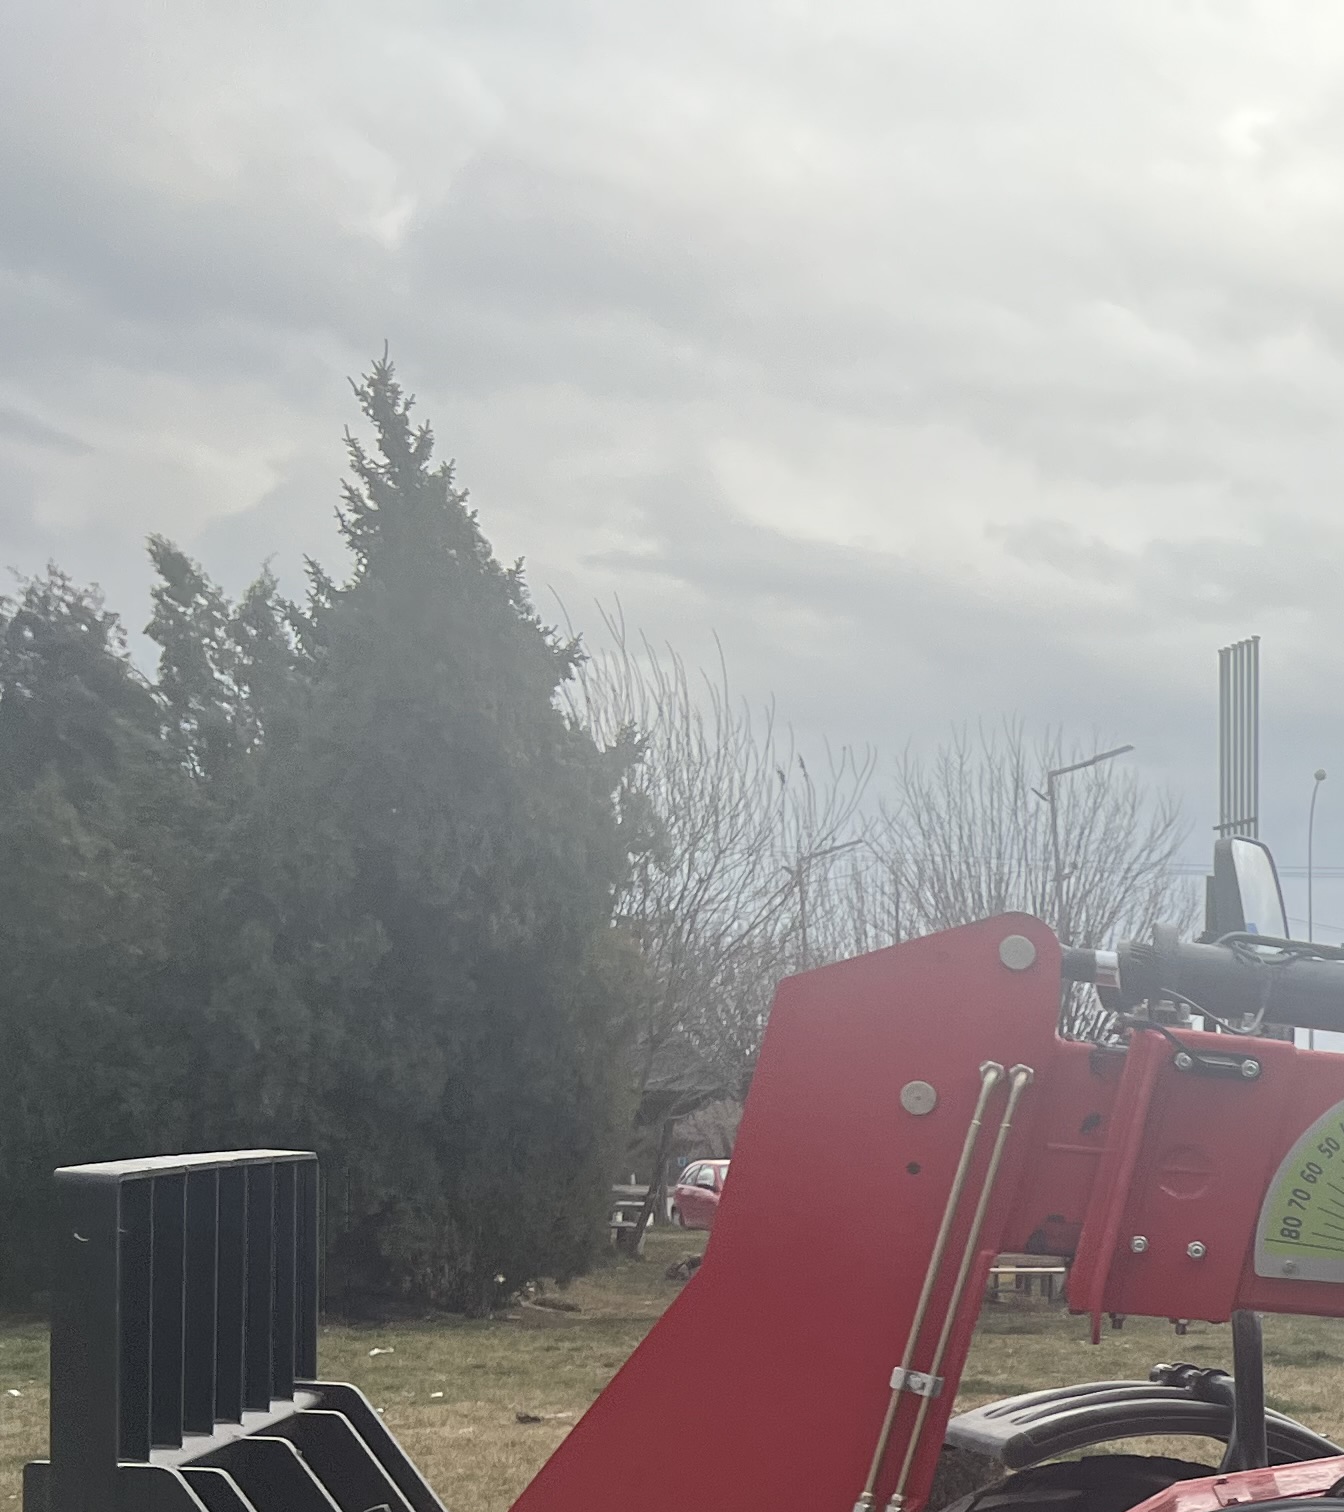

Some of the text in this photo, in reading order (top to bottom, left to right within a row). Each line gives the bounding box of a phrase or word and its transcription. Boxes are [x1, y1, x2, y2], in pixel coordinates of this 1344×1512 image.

[1317, 1136, 1341, 1160] 50
[1300, 1161, 1323, 1184] 60
[1287, 1188, 1312, 1211] 70
[1279, 1215, 1303, 1240] 80
